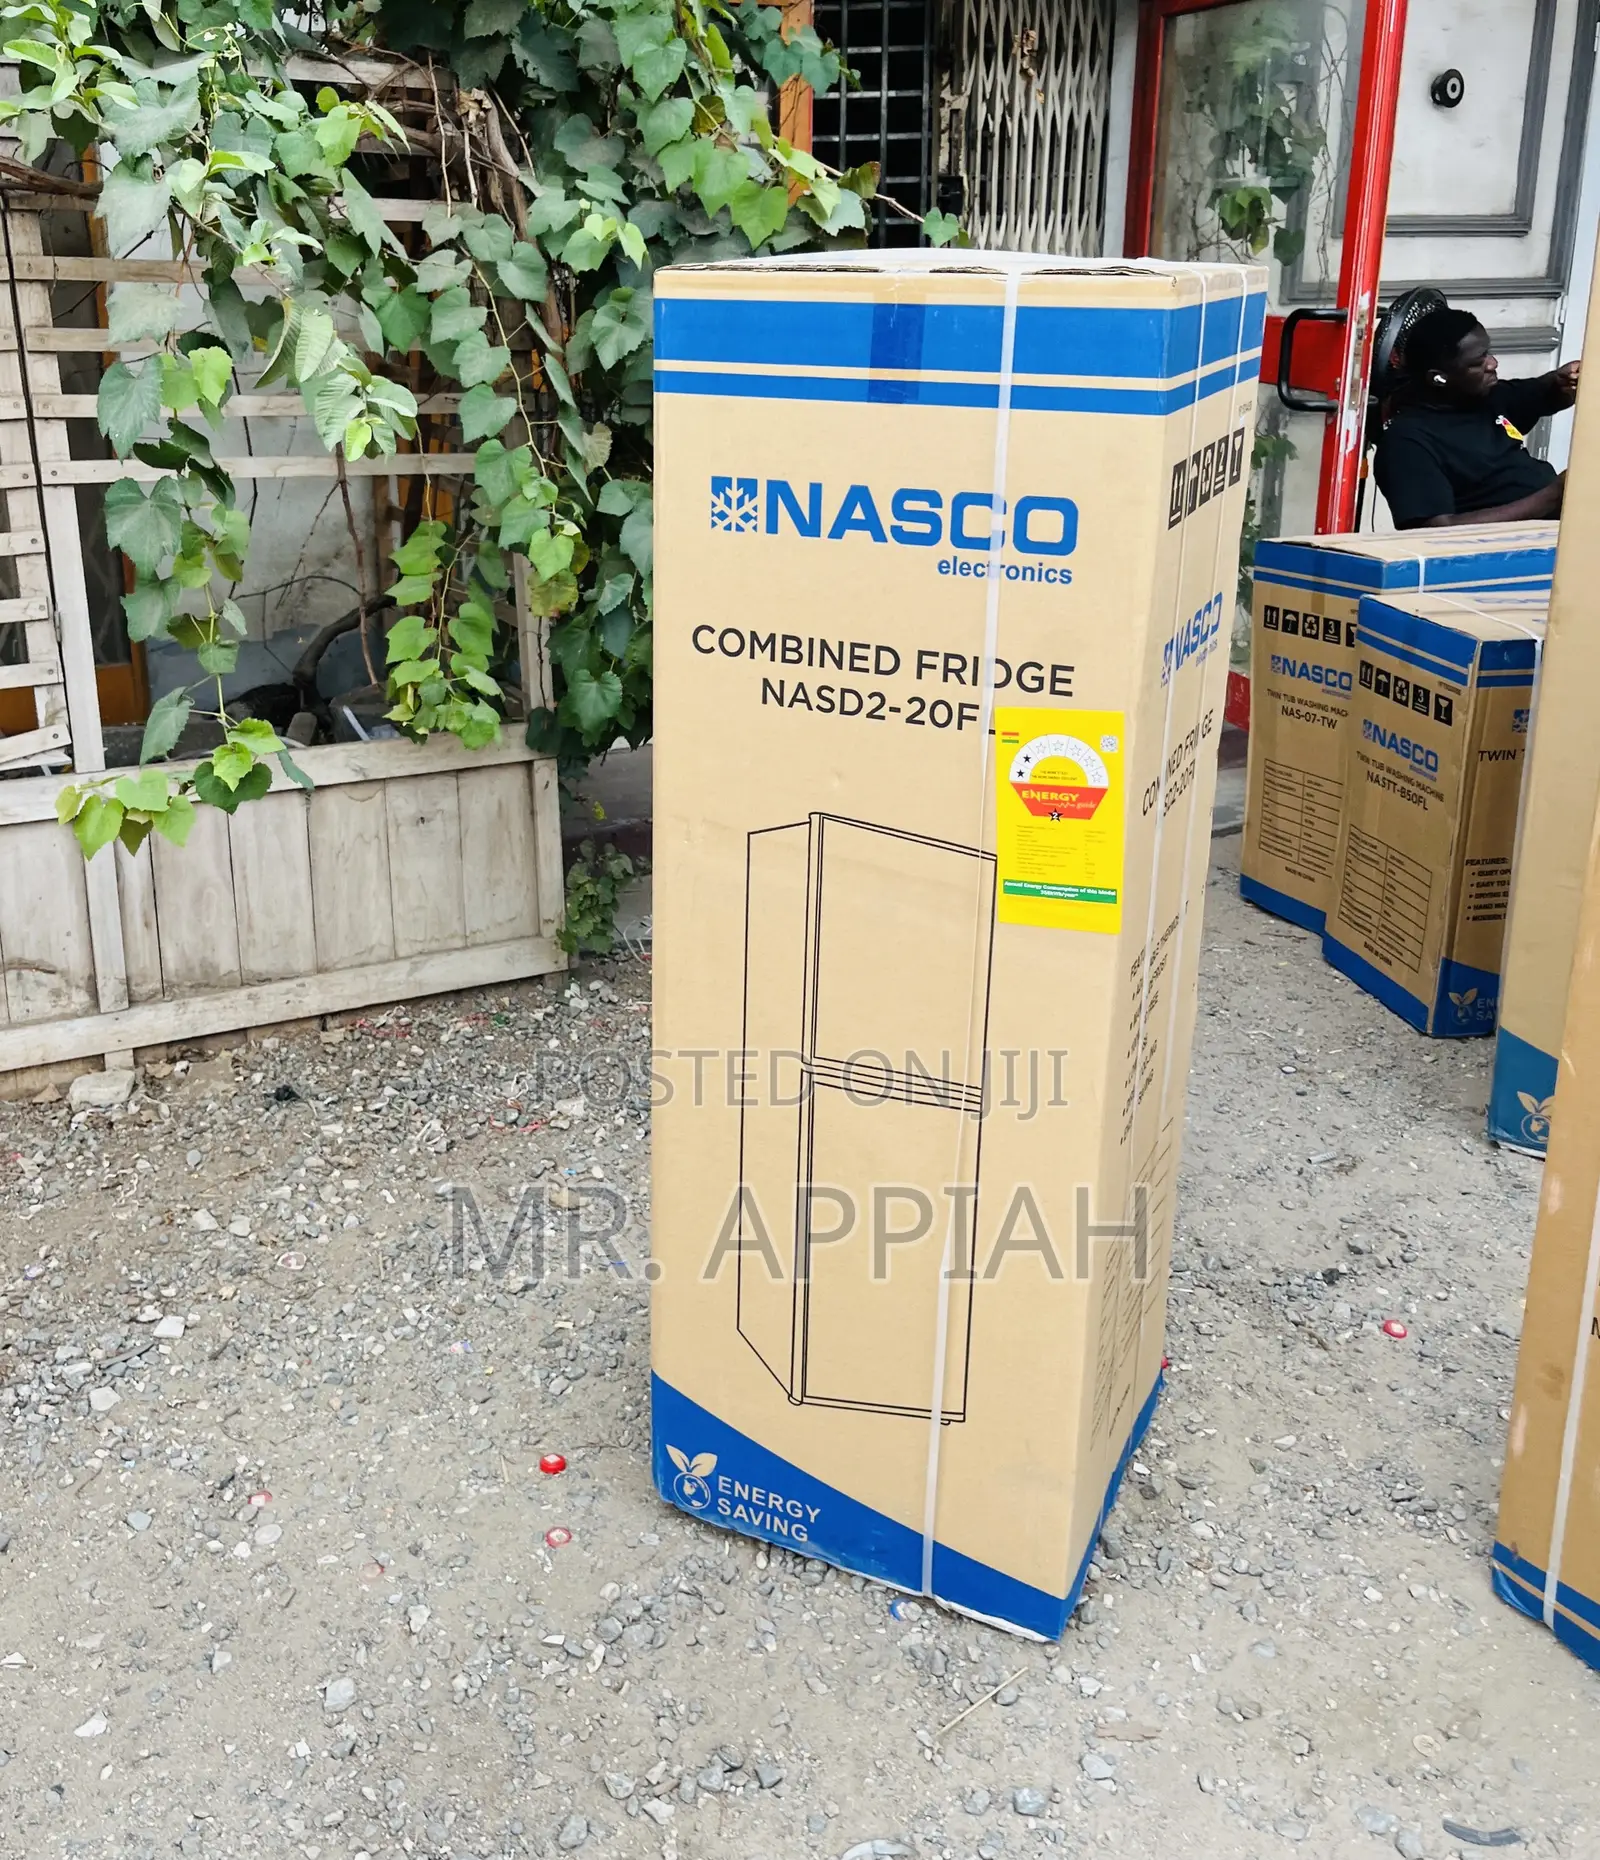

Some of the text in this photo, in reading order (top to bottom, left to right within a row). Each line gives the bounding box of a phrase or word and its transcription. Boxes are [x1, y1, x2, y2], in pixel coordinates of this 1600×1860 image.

[765, 479, 1079, 556] NASCO
[1175, 591, 1223, 671] NASCO
[692, 624, 1075, 697] COMBINED FRIDGE
[1282, 657, 1353, 691] NASCO
[761, 677, 995, 735] NASD2-20F
[1267, 688, 1281, 700] TWIN
[1283, 693, 1296, 703] TUB
[1281, 705, 1338, 729] NAS-07-TW
[1183, 708, 1214, 761] FRIGE
[1372, 723, 1439, 773] NASCO
[1478, 749, 1517, 762] TWIN
[1371, 758, 1385, 771] TUB
[1021, 789, 1080, 804] ENERGY
[717, 1497, 808, 1543] SAVING
[718, 1475, 821, 1524] ENERGY
